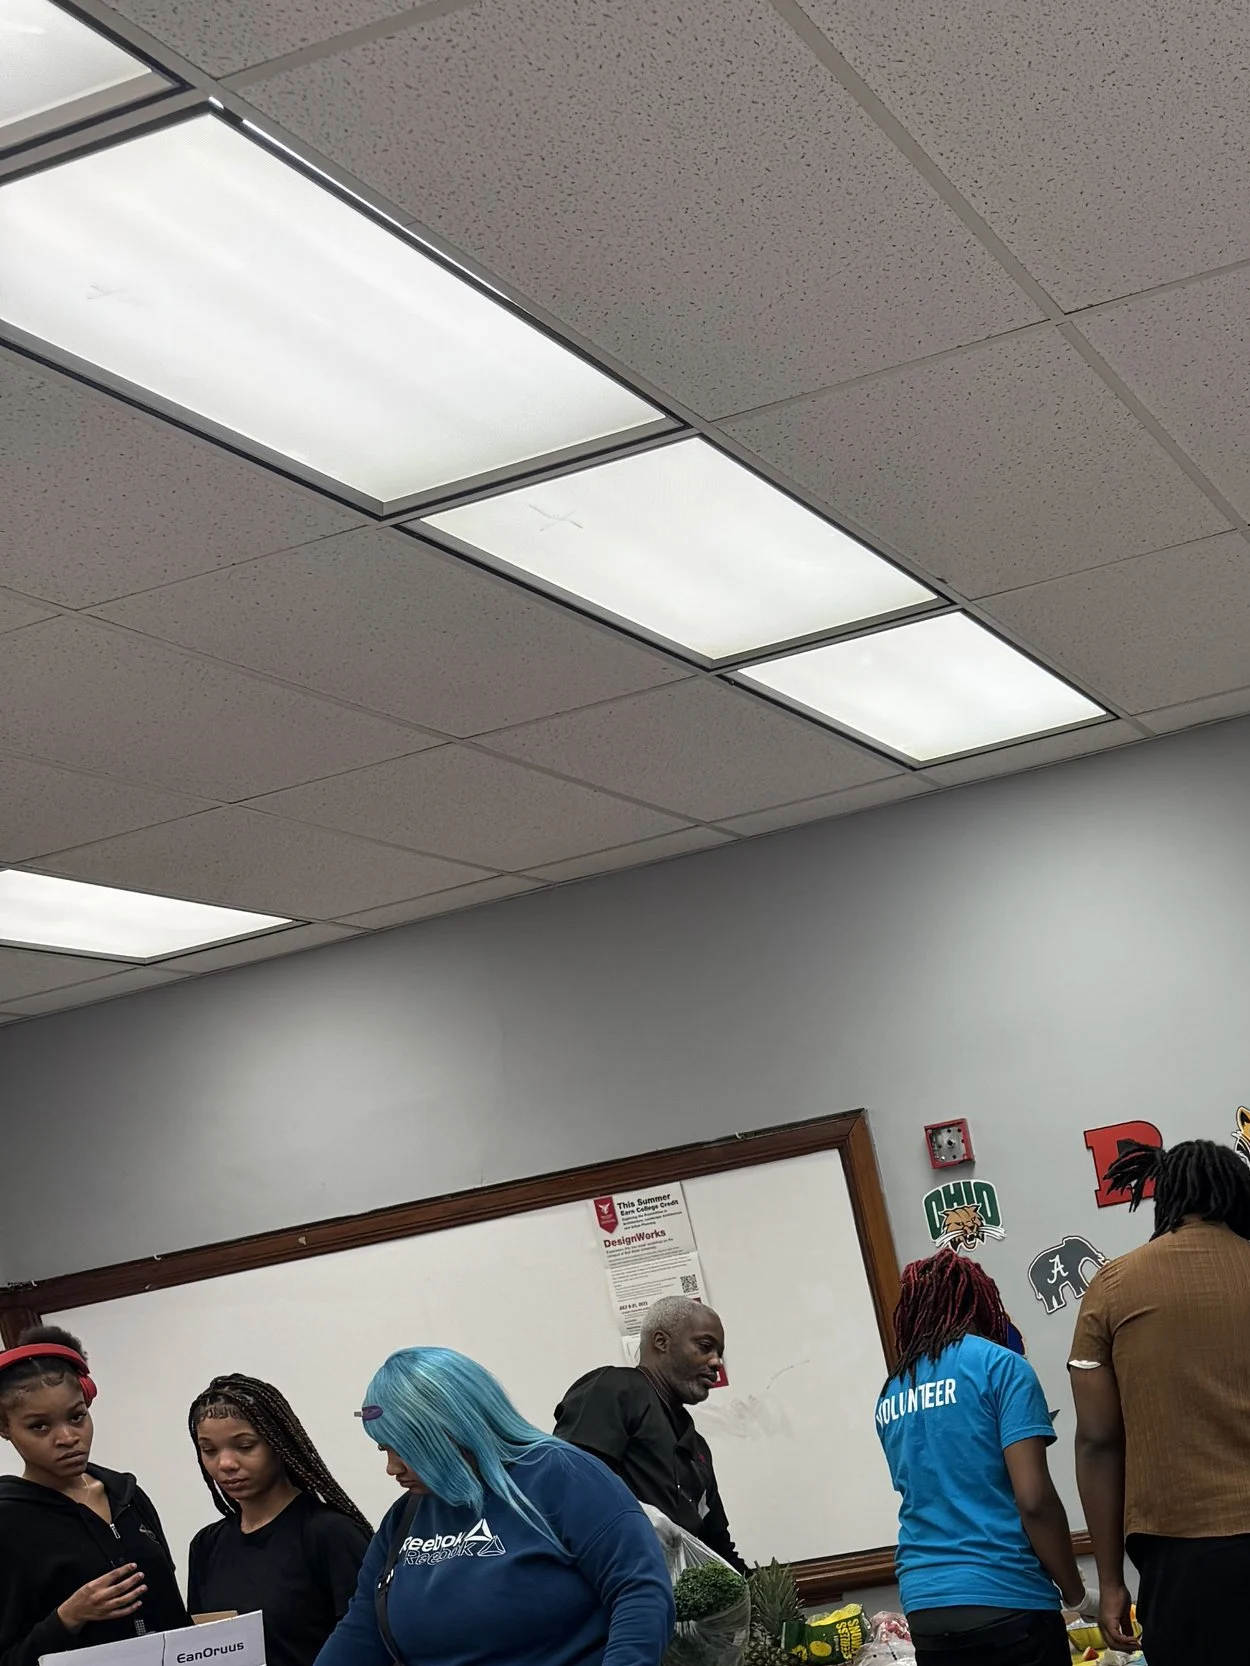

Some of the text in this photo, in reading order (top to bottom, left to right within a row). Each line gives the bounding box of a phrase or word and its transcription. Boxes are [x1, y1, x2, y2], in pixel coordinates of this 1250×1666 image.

[617, 1193, 671, 1210] This Summer
[620, 1199, 679, 1217] Earn College Credit
[923, 1181, 1001, 1241] OHIO
[603, 1229, 667, 1248] DesignWorks
[1046, 1254, 1069, 1284] A
[876, 1378, 957, 1428] VOLUNTEER
[399, 1532, 467, 1554] Reebok
[176, 1642, 245, 1664] EanOruus
